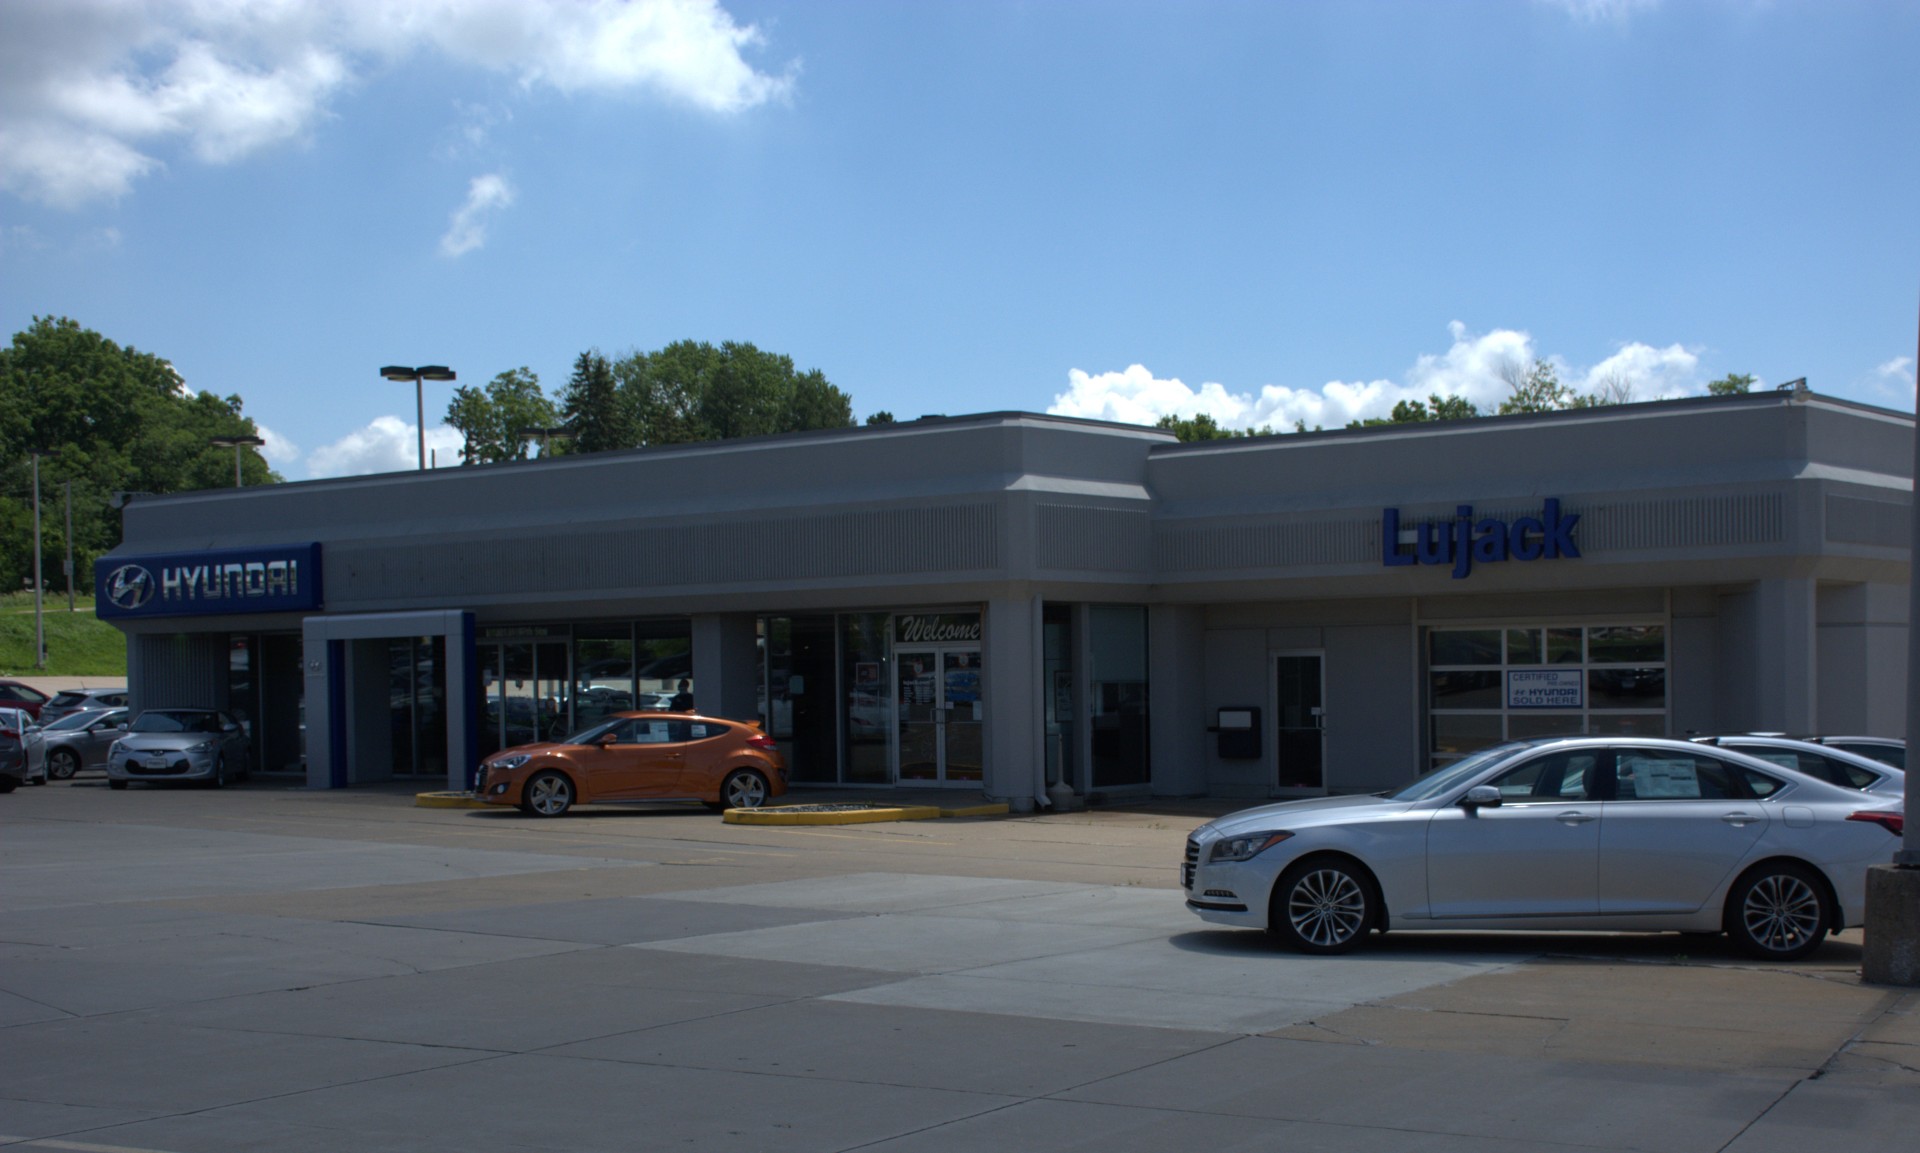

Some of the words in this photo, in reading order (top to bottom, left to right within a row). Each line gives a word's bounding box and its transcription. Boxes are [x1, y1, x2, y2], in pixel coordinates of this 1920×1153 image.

[1383, 498, 1581, 579] Lujack
[162, 559, 298, 601] HYUNDAI
[902, 615, 980, 642] Welcome
[1512, 673, 1559, 681] CERTIFIED
[1512, 696, 1544, 705] SOLD
[1546, 696, 1577, 705] HERE
[1529, 688, 1578, 696] HYUNDAI
